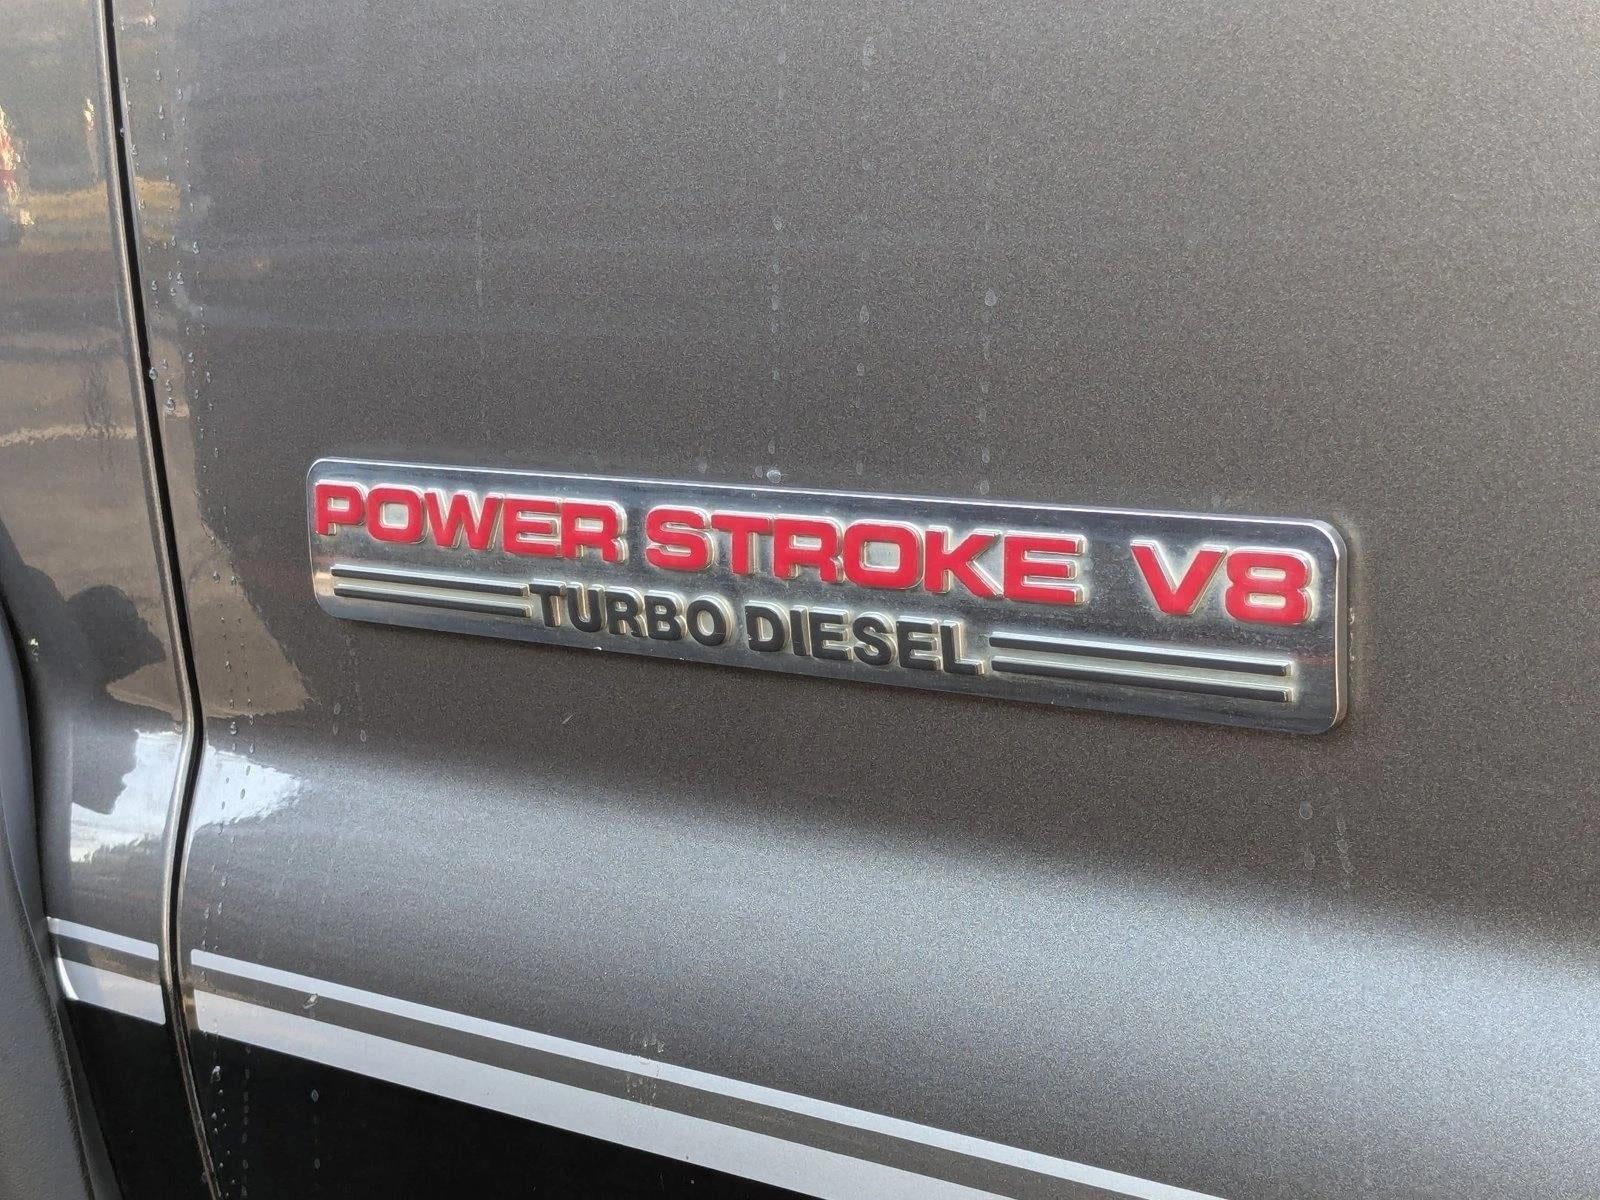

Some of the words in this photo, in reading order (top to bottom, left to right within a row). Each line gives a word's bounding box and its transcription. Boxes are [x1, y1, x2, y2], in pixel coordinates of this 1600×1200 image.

[314, 482, 627, 564] POWER
[644, 506, 1086, 606] STROKE
[1131, 541, 1313, 627] V8
[530, 579, 735, 647] TURBO
[744, 600, 984, 676] DIESEL
